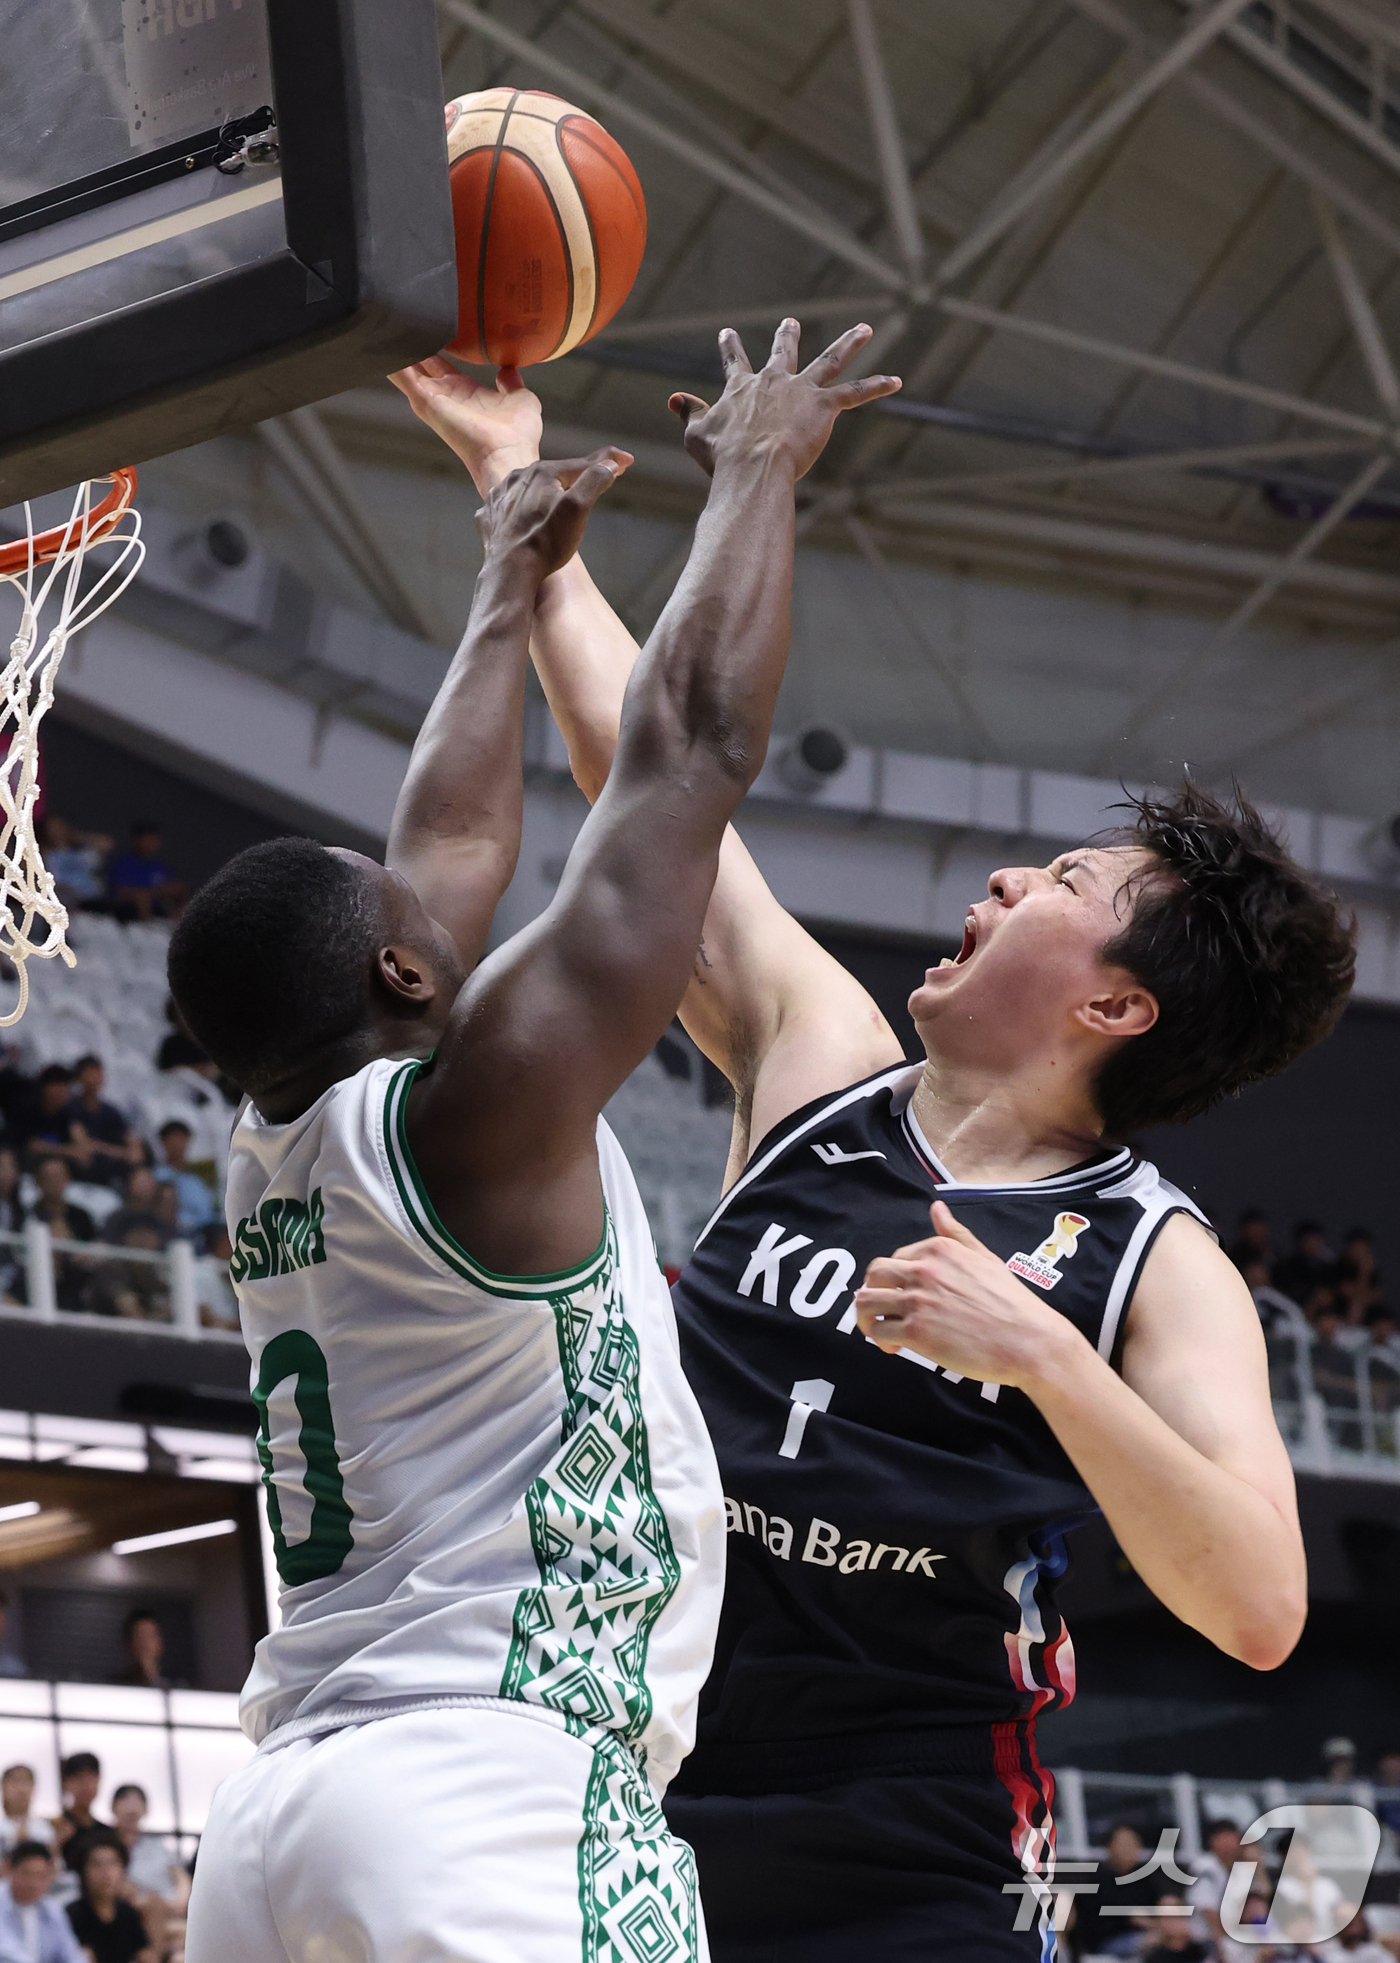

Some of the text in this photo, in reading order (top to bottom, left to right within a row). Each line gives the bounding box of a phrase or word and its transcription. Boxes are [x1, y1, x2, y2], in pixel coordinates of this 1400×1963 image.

[1008, 1260, 1053, 1288] QUALIFIERS
[1015, 1256, 1041, 1273] WORLD
[1041, 1269, 1057, 1281] CUP
[252, 1329, 355, 1586] 0
[777, 1378, 835, 1460] 1
[724, 1496, 948, 1579] ana Bank
